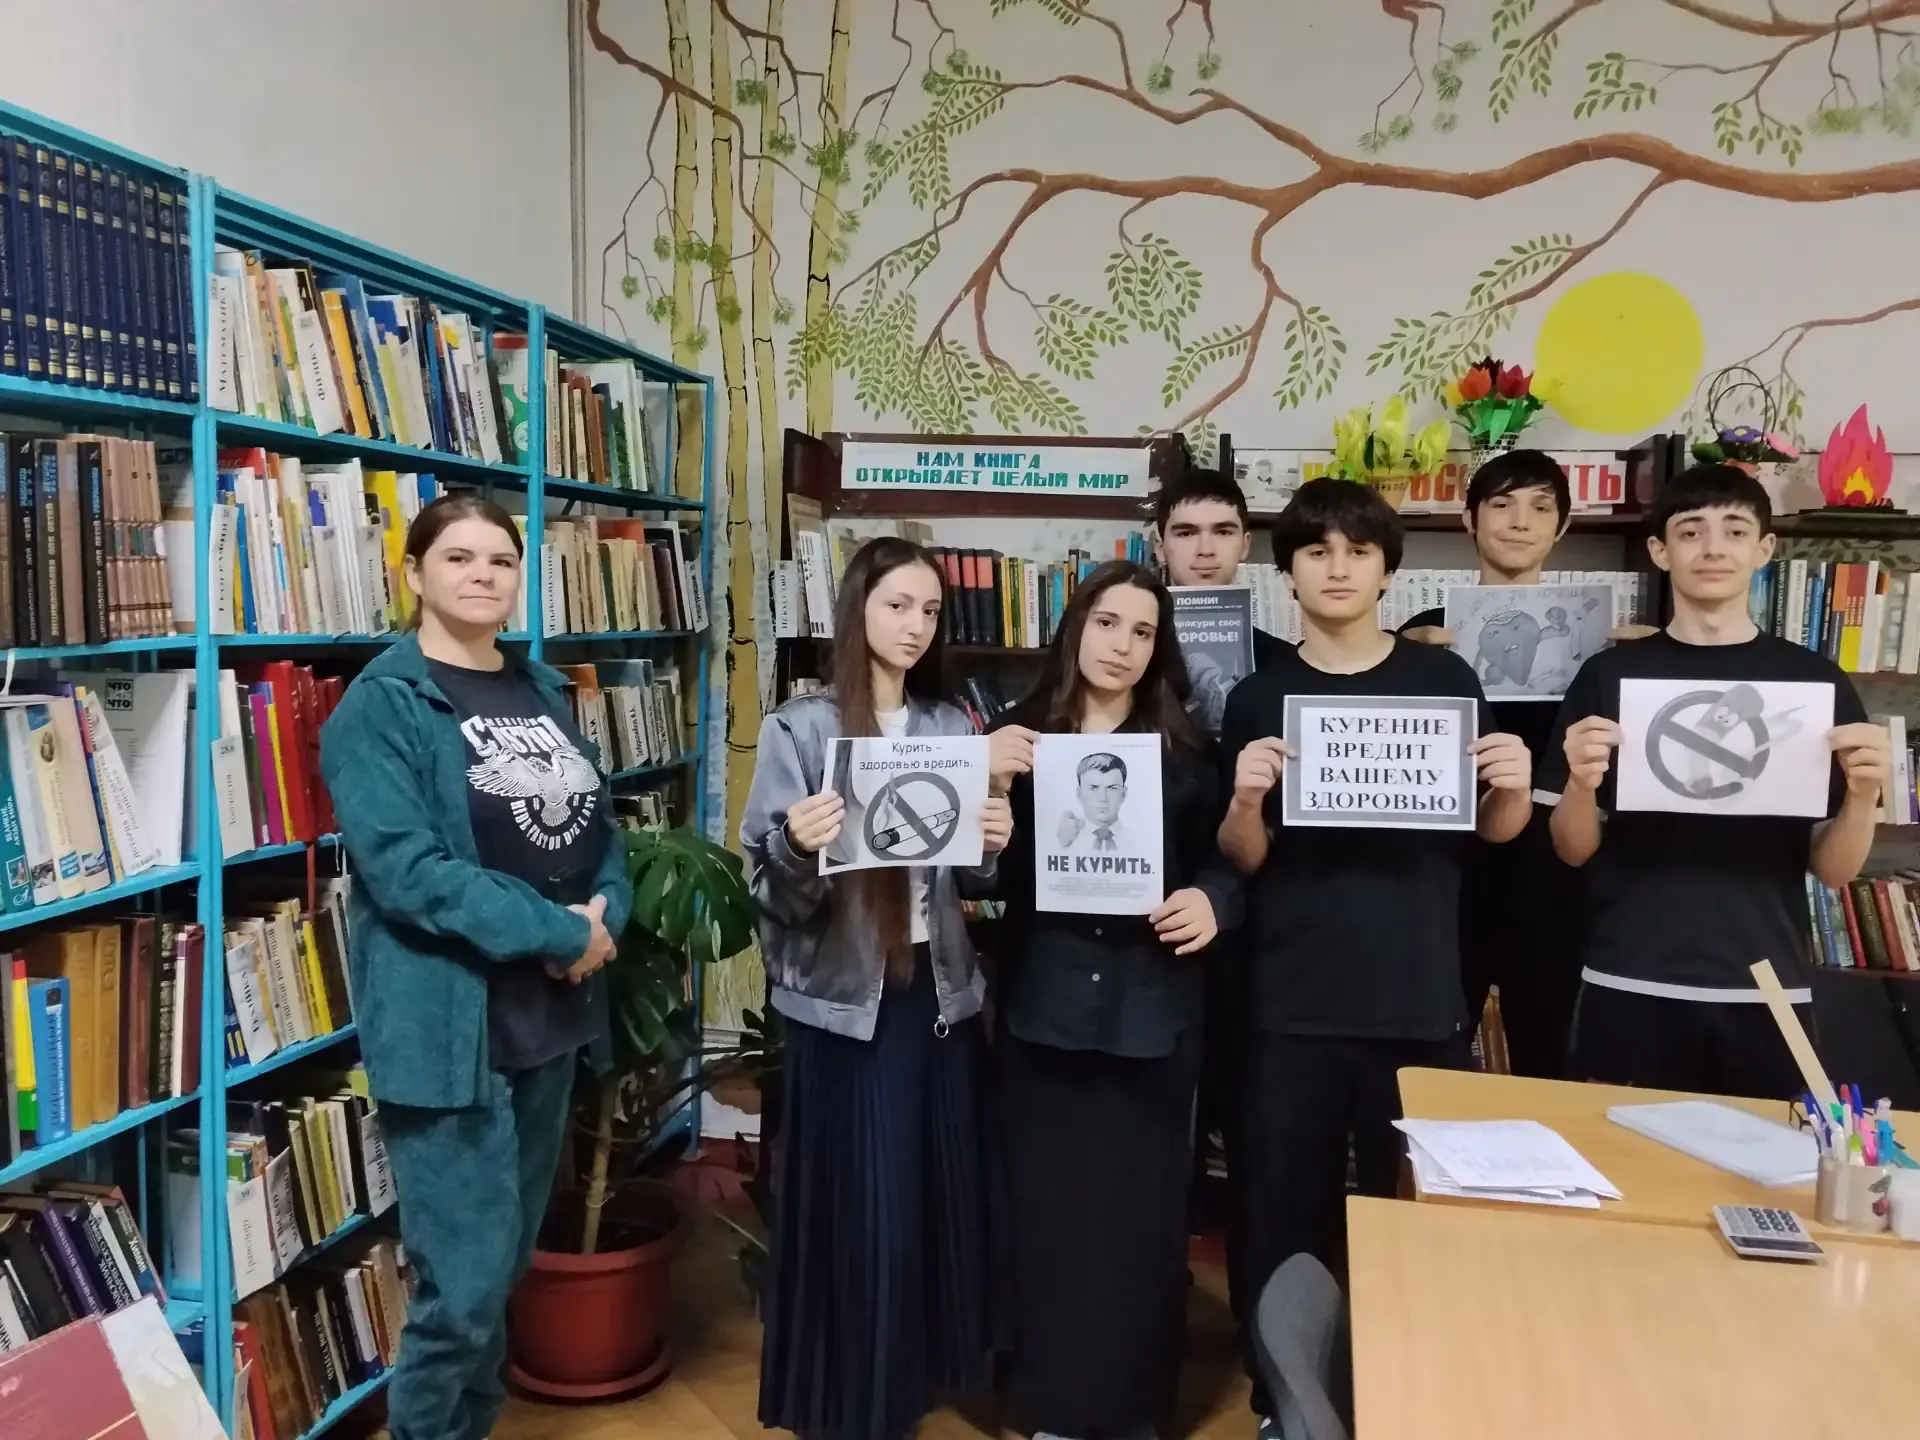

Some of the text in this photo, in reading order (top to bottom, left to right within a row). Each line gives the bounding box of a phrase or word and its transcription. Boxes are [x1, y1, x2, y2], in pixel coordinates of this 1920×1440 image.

[916, 452, 1041, 469] НАМ КНИГА
[855, 467, 1129, 489] ОТКРЫВАЕТ ЦЕЛЫЙ МИР
[1176, 596, 1219, 606] ПОМНИ!
[1178, 632, 1239, 643] ОРОВЬЕ!
[1320, 716, 1450, 736] КУРЕНИЕ
[892, 742, 932, 756] Курить
[1326, 742, 1433, 761] ВРЕДИТ
[859, 758, 974, 772] здоровью вредить.
[1320, 767, 1445, 786] ВАШЕМУ
[1305, 791, 1457, 813] ЗДОРОВЬЮ
[1047, 855, 1155, 875] НЕ КУРИТЬ.
